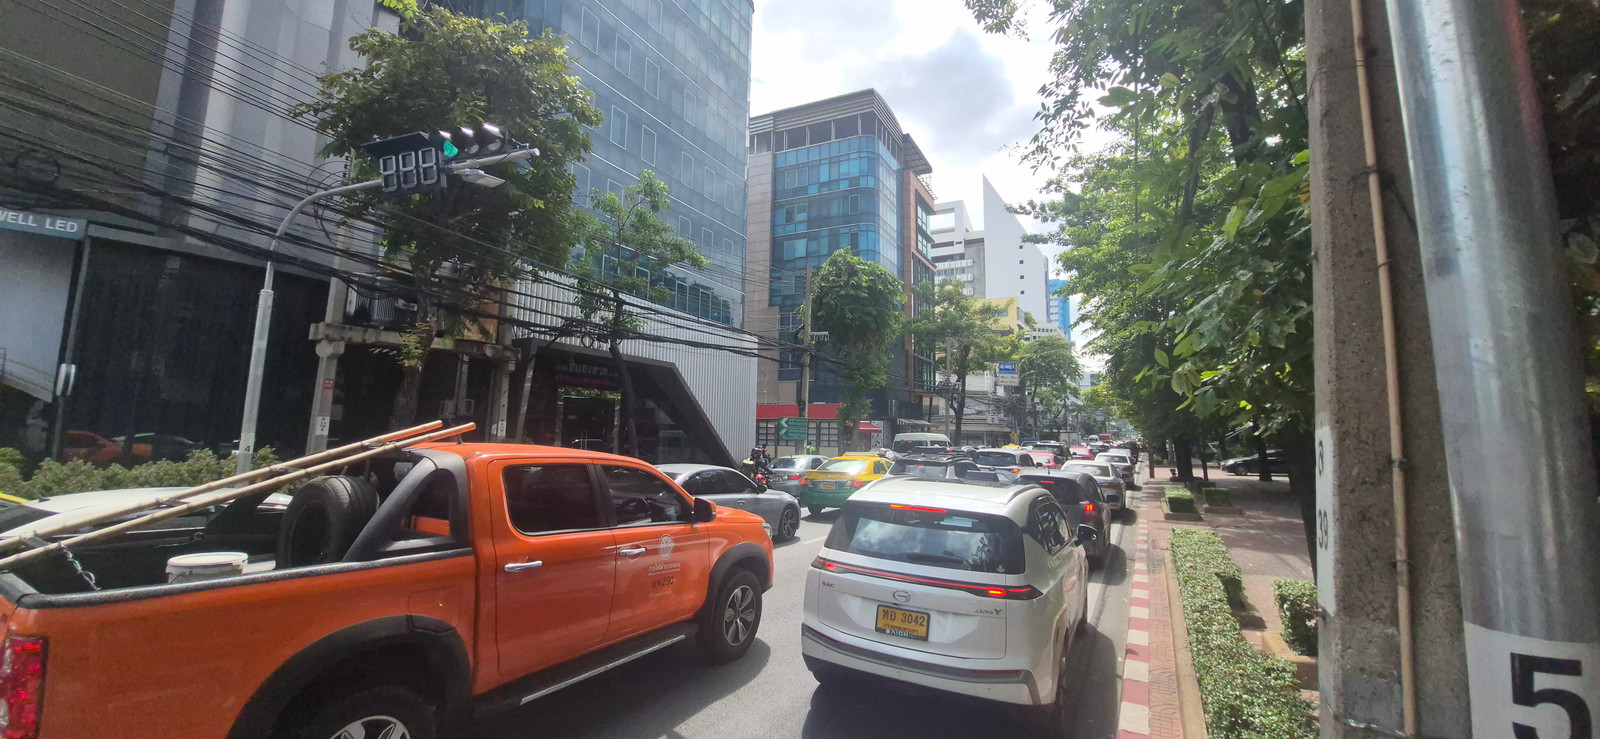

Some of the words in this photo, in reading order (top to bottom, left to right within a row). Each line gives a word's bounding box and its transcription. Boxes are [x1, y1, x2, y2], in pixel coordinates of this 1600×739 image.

[45, 218, 78, 232] LED
[1318, 508, 1329, 551] 39
[901, 612, 926, 627] 3042
[1510, 652, 1593, 739] 5
